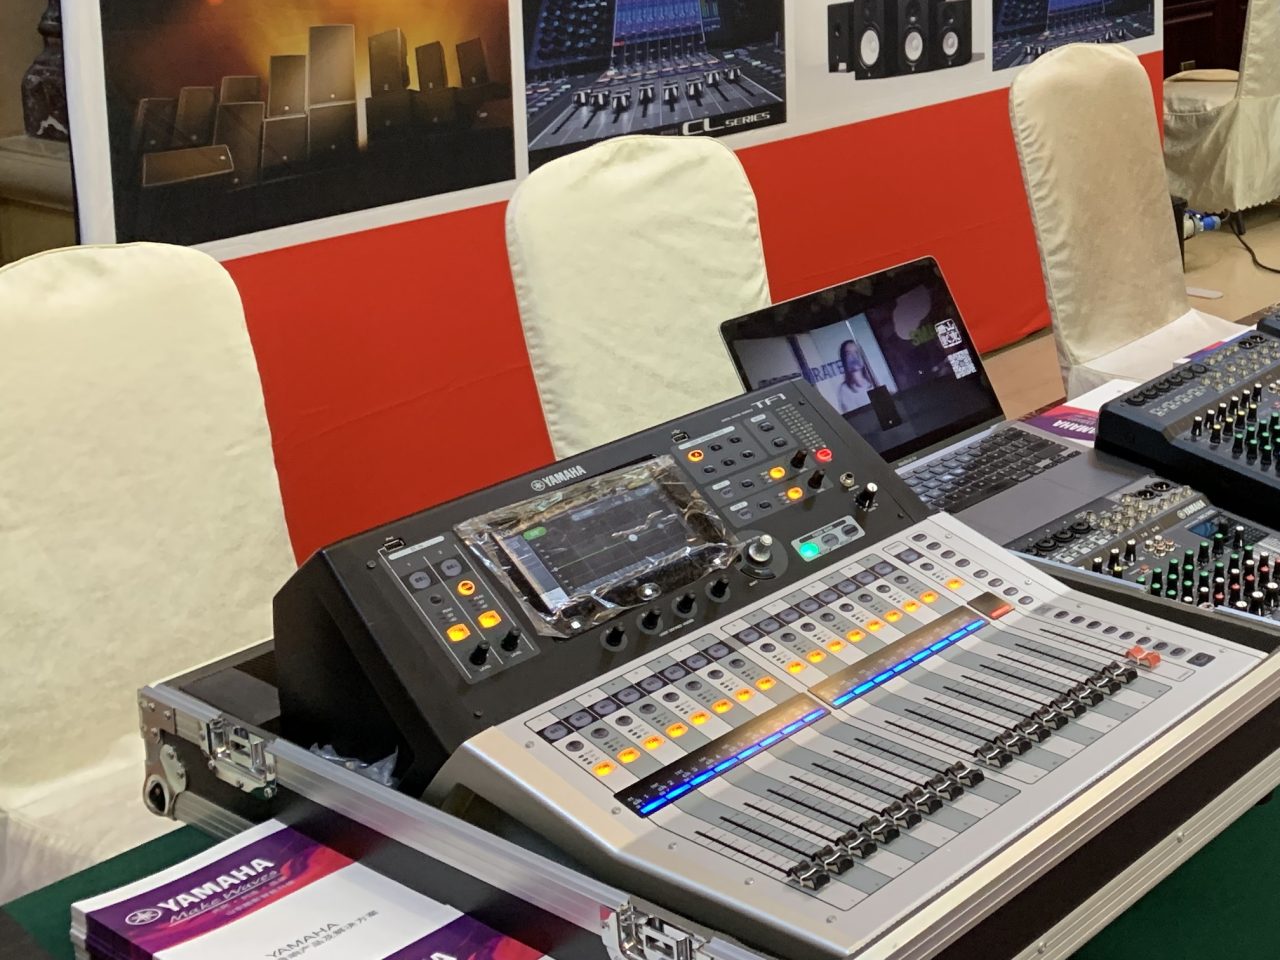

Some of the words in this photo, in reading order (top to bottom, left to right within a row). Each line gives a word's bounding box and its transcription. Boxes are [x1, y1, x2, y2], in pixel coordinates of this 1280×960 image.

[681, 116, 726, 136] CL
[724, 110, 771, 129] SERIES
[751, 393, 786, 409] TF1
[541, 465, 587, 487] YAMAHA
[158, 858, 275, 912] YAMAHA
[265, 921, 339, 959] YAMAHA
